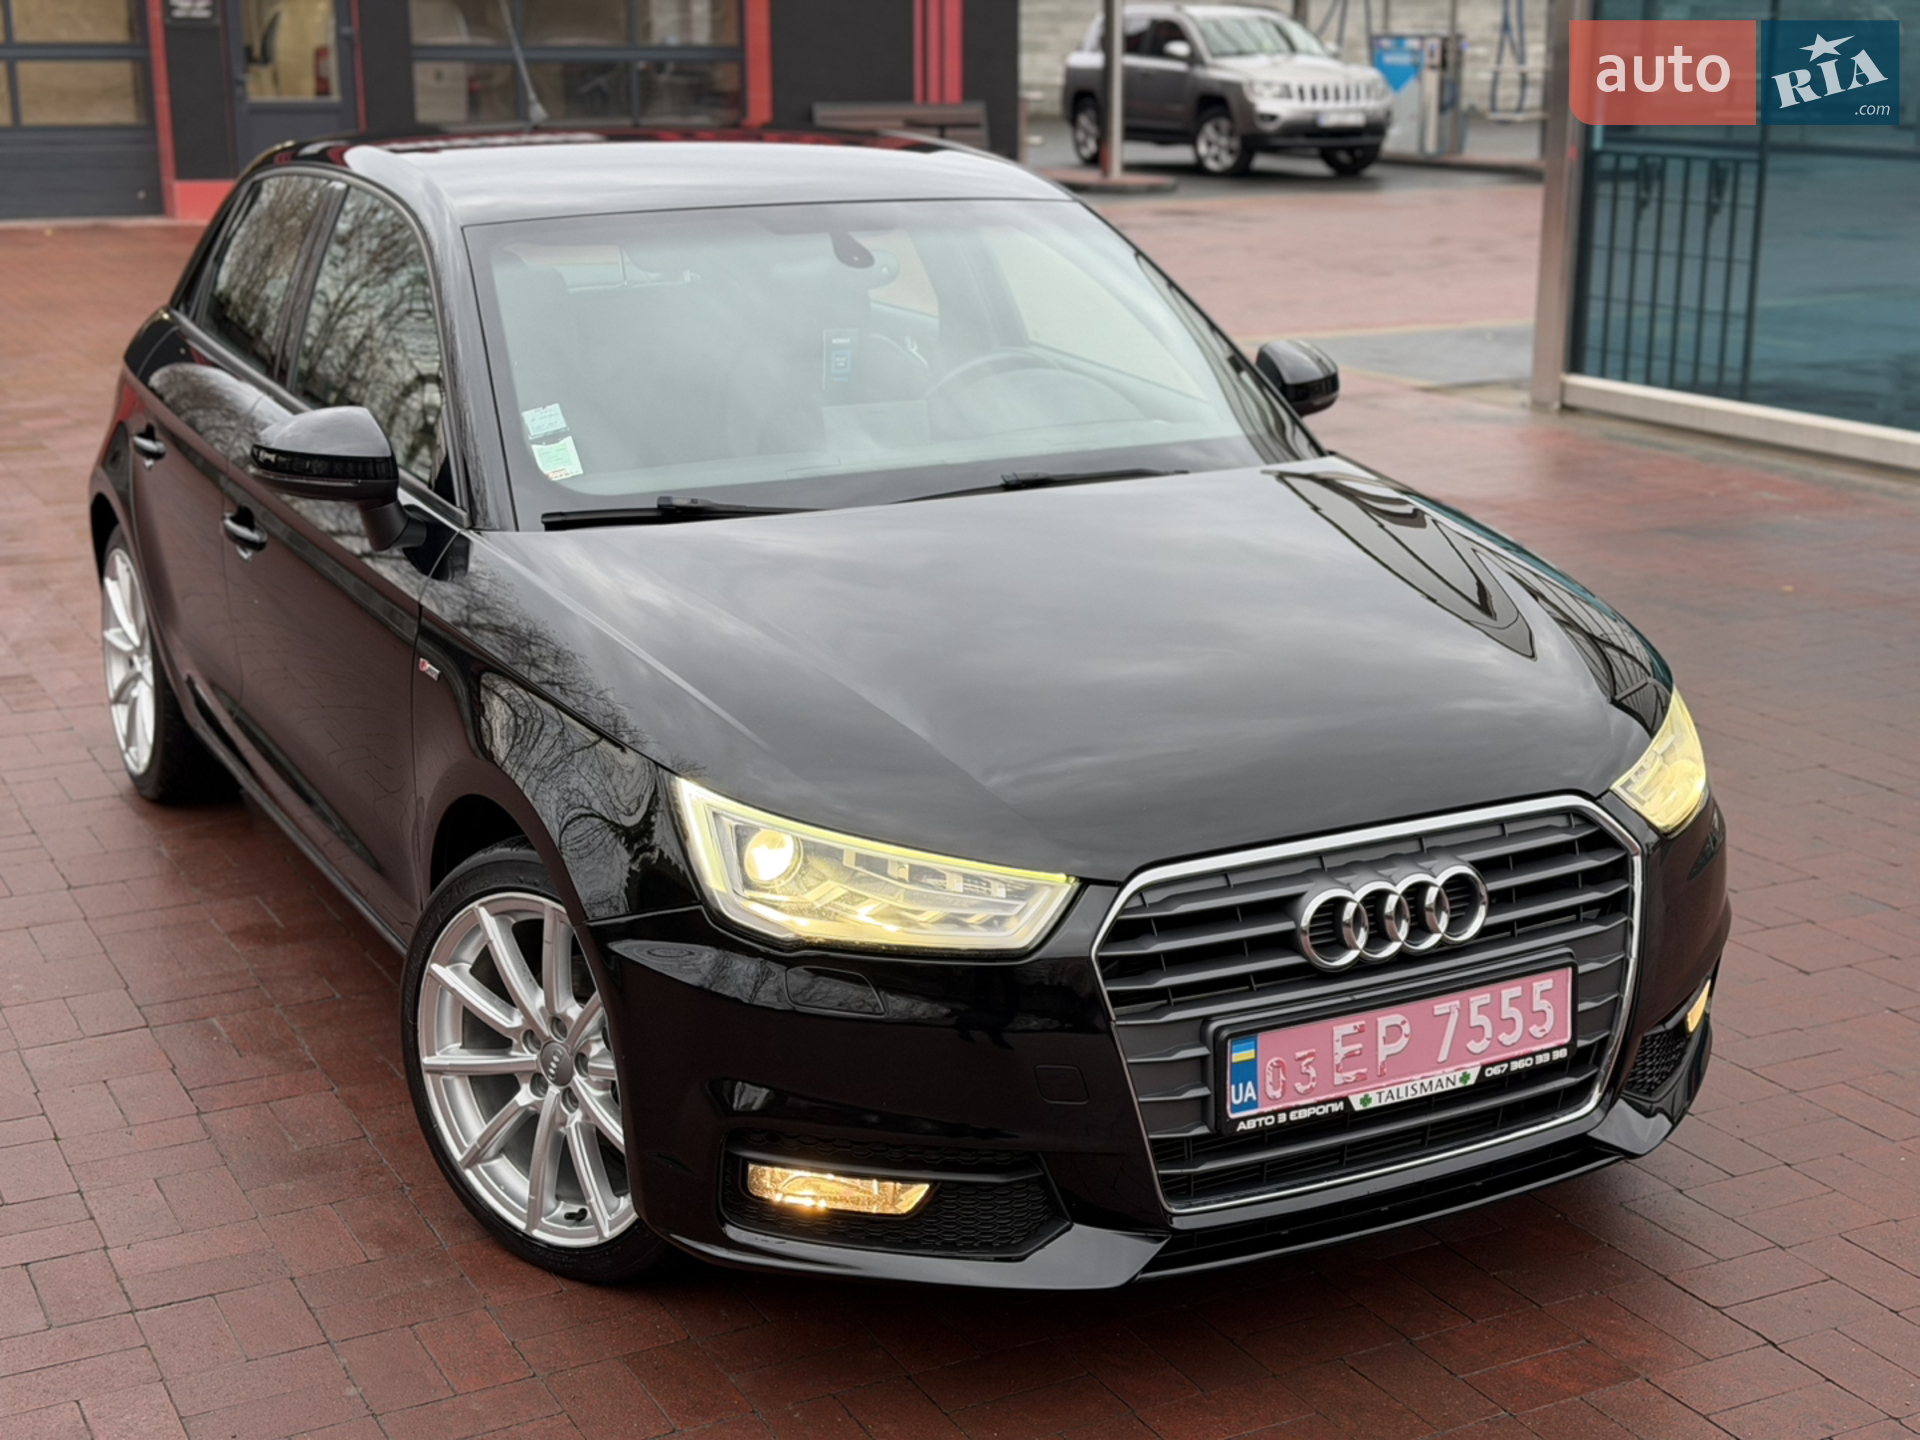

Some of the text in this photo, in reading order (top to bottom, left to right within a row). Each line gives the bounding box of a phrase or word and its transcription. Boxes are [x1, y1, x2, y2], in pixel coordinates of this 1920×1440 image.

[1264, 978, 1555, 1100] 03 EP 7555
[1484, 1063, 1509, 1078] 067
[1510, 1057, 1534, 1072] 360
[1231, 1080, 1257, 1105] UA
[1375, 1074, 1457, 1105] TALISMAN
[1236, 1115, 1275, 1132] АВТО
[1289, 1101, 1345, 1121] ЄВРОПИ
